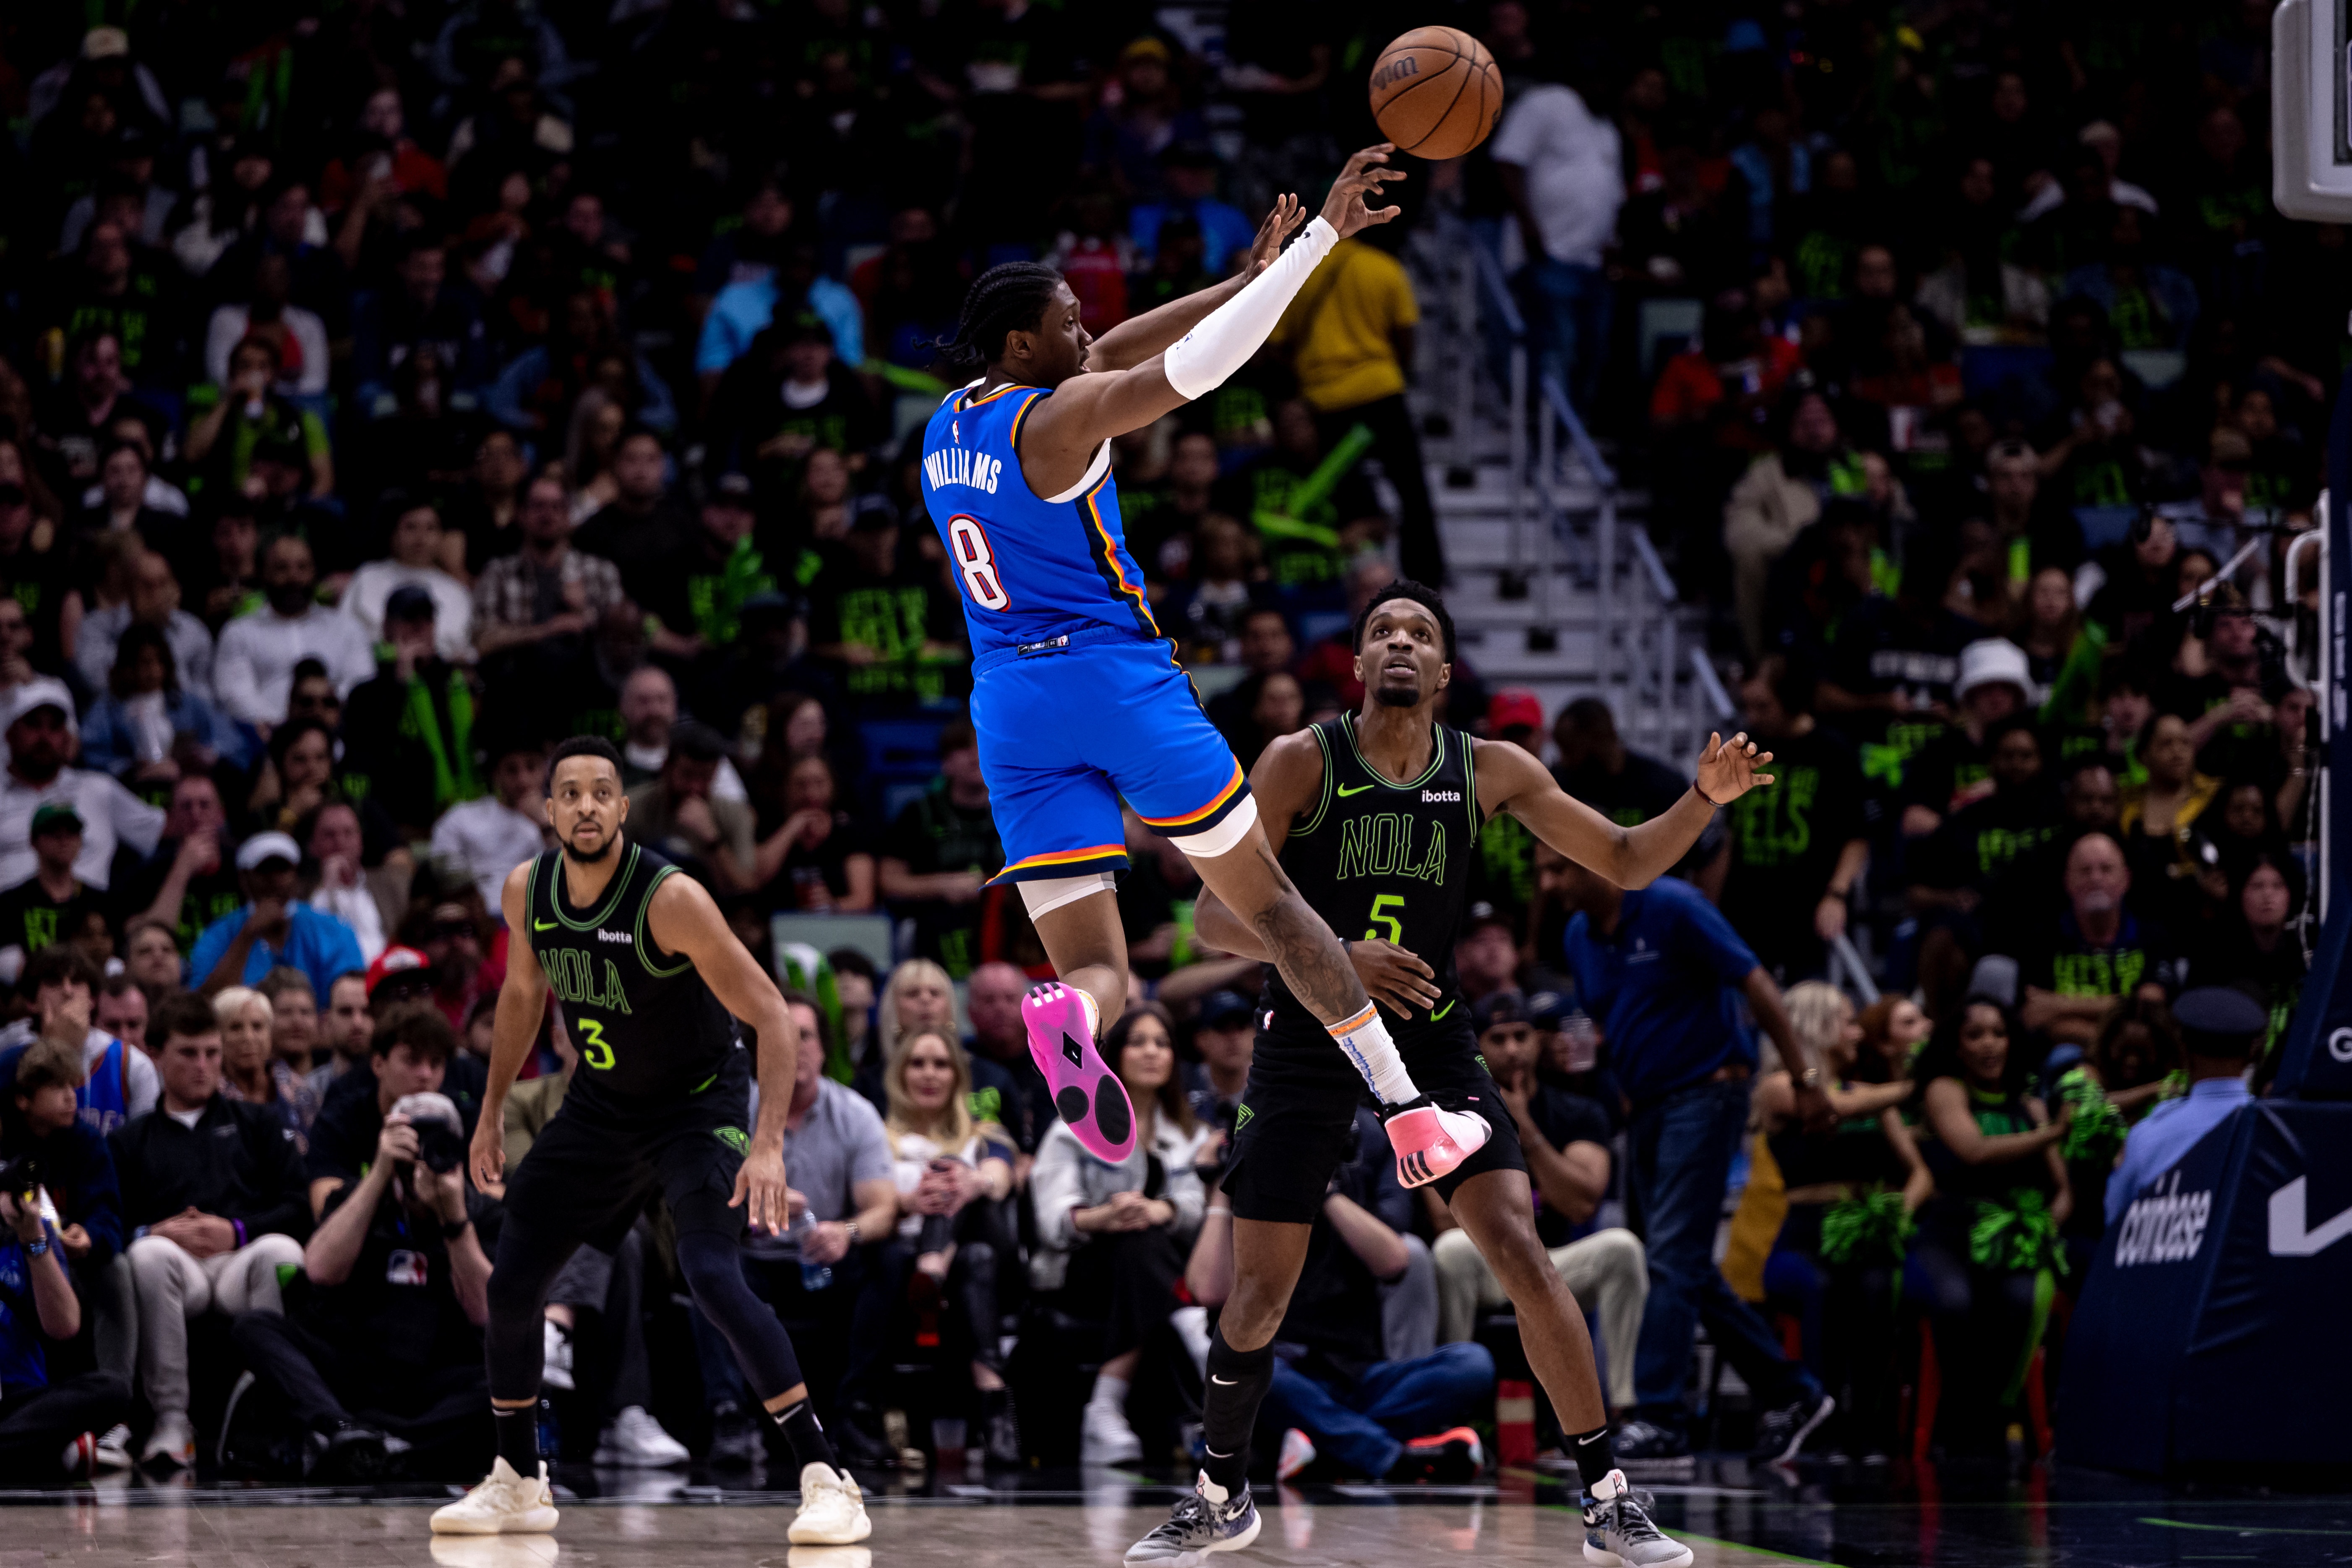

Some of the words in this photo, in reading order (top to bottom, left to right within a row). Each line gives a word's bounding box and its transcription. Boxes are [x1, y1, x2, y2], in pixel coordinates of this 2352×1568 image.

[923, 448, 1002, 494] WILLIAMS
[947, 513, 1012, 613] 8
[1421, 789, 1460, 802] ibotta
[1337, 813, 1447, 886] NOLA
[597, 928, 633, 944] ibotta
[1364, 893, 1405, 945] 5
[540, 948, 633, 1015] NOLA
[578, 1018, 616, 1070] 3
[2115, 1169, 2212, 1269] coinbase
